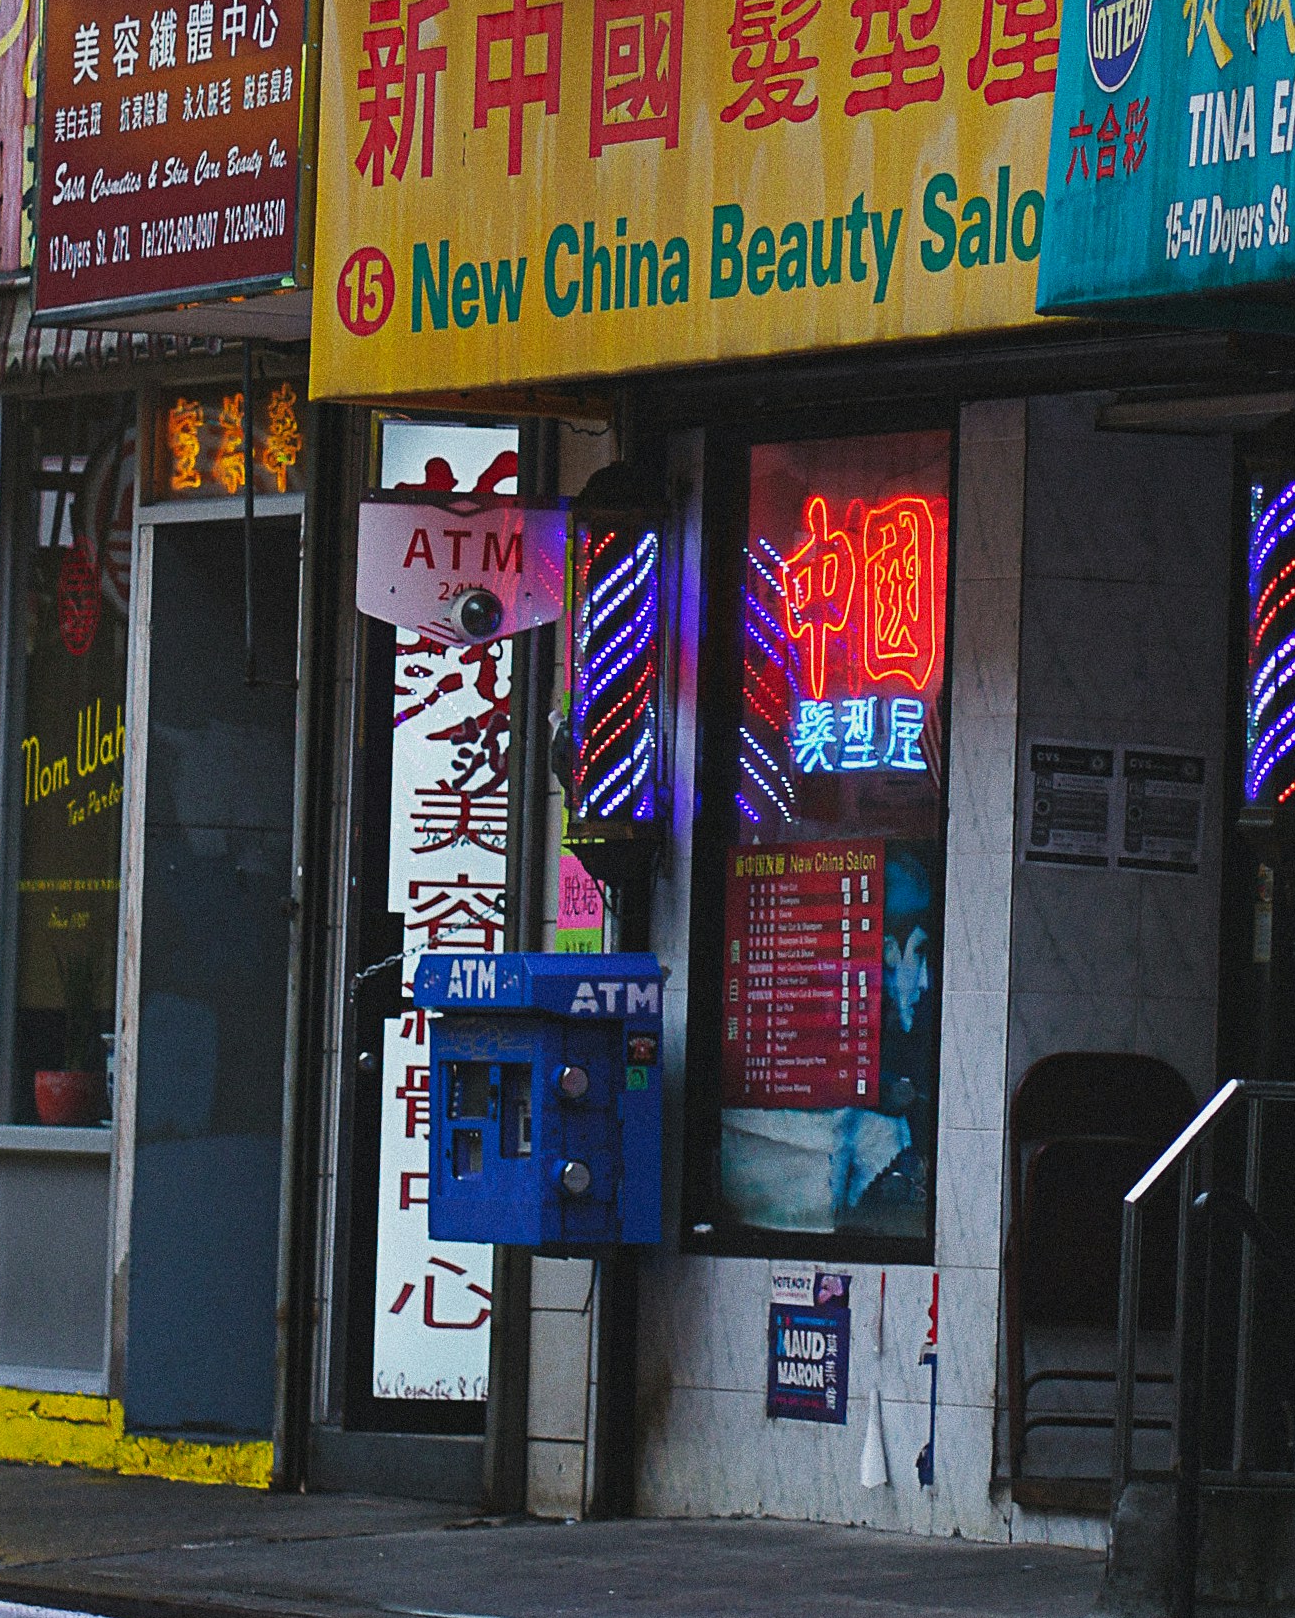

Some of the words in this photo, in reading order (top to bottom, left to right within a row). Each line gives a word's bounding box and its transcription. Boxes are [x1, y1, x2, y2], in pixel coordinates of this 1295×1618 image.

[1065, 95, 1150, 184] 六合彩
[1188, 84, 1256, 168] TINA
[52, 161, 85, 206] Sasa
[90, 167, 141, 203] Cosmetics
[148, 160, 159, 190] &
[162, 156, 189, 188] Skin
[193, 150, 221, 187] Care
[227, 145, 263, 180] Beauty
[1209, 190, 1264, 264] Doyers
[1268, 183, 1290, 245] St.
[49, 236, 59, 273] 13
[61, 234, 91, 279] Doyers
[344, 257, 386, 325] 15
[410, 239, 528, 333] New
[543, 218, 690, 318] China
[710, 192, 903, 303] Beauty
[402, 527, 524, 574] ATM
[21, 735, 71, 807] Nom
[76, 696, 125, 777] Wah
[815, 851, 844, 873] China
[846, 850, 877, 872] Salon
[447, 959, 496, 999] ATM
[569, 981, 659, 1015] ATM
[776, 1327, 826, 1362] MAUD
[776, 1361, 825, 1389] MARON
